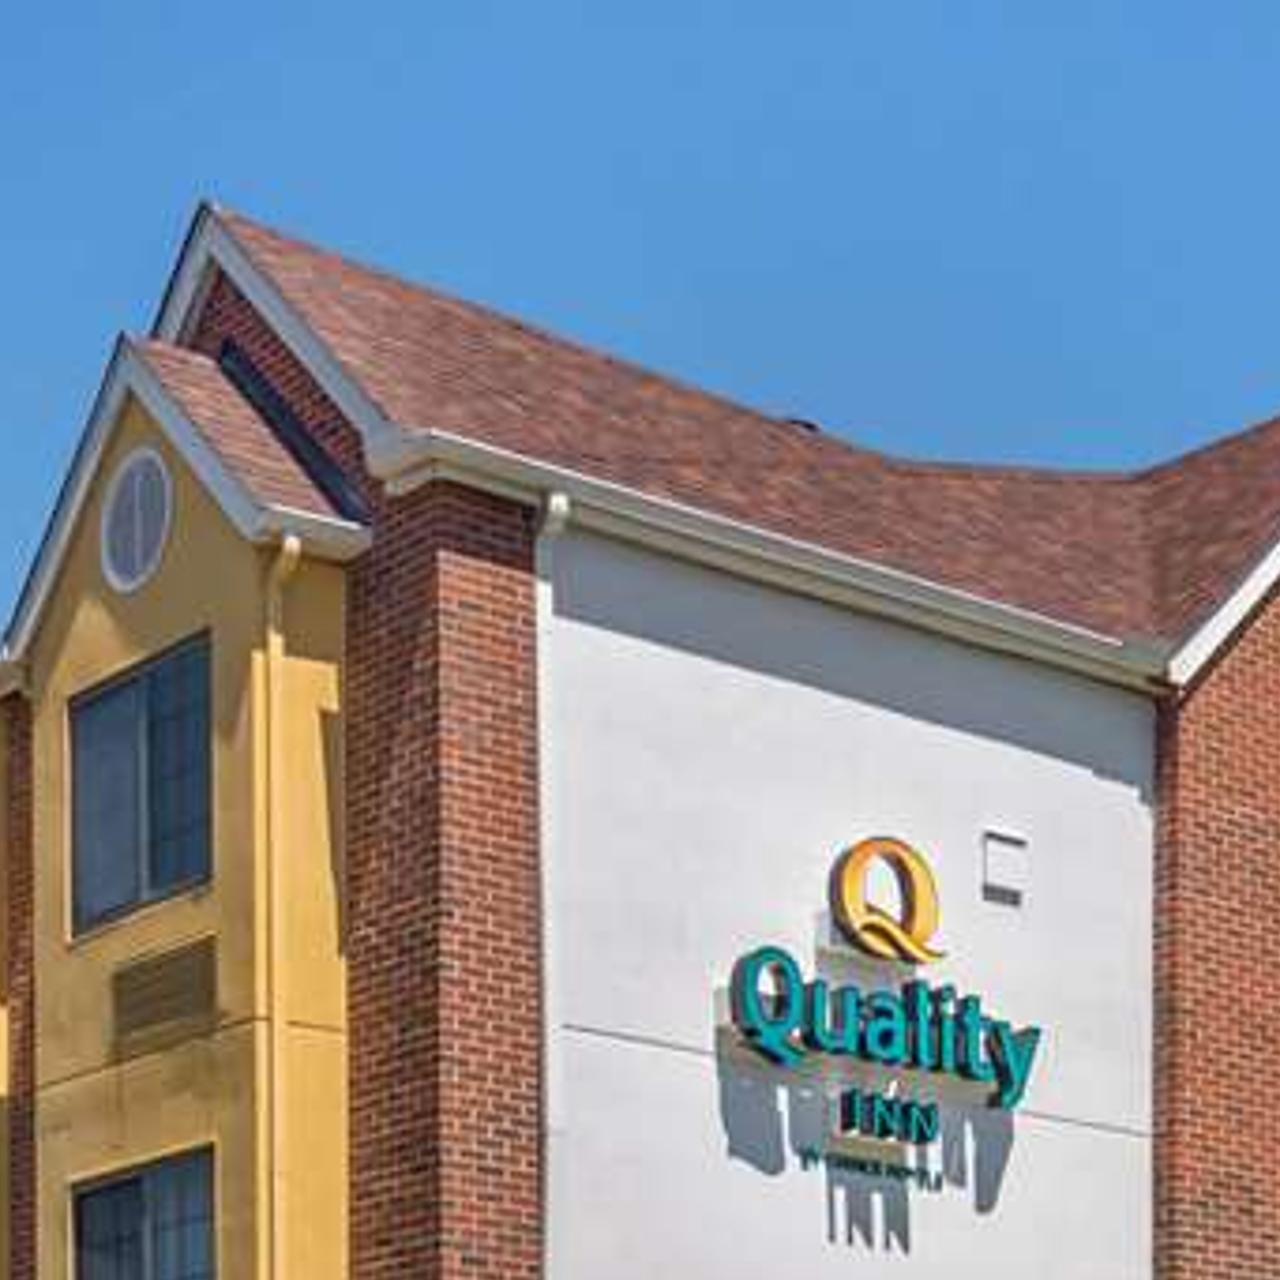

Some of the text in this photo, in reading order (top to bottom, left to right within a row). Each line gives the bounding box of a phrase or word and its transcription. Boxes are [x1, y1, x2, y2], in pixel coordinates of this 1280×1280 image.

[829, 836, 946, 963] Q
[730, 946, 1041, 1110] Quality
[840, 1088, 940, 1145] INN
